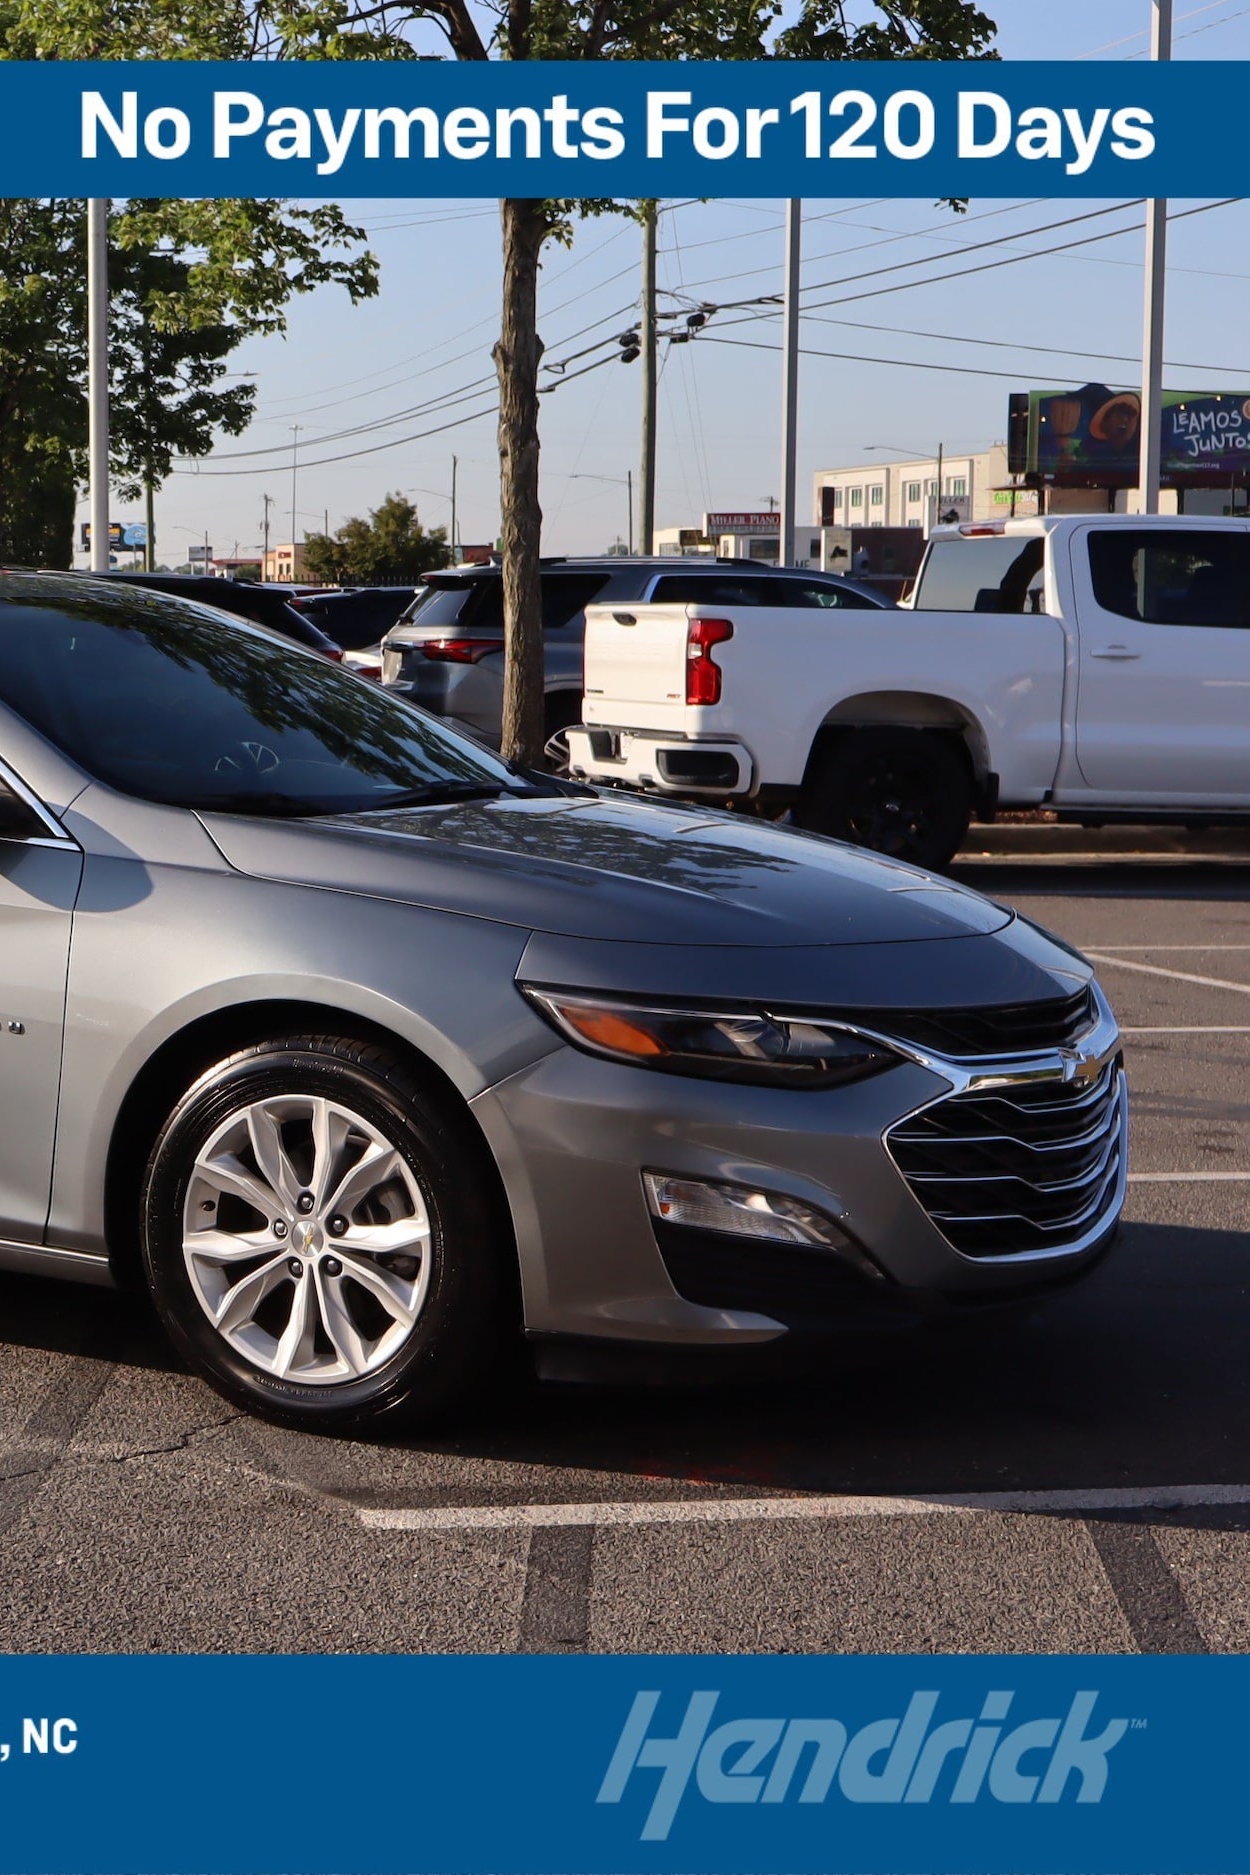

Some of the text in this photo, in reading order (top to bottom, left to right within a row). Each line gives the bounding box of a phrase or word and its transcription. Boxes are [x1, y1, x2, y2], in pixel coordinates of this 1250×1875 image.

[1173, 410, 1242, 433] LEAMOS
[711, 514, 780, 525] MILLER PIANO
